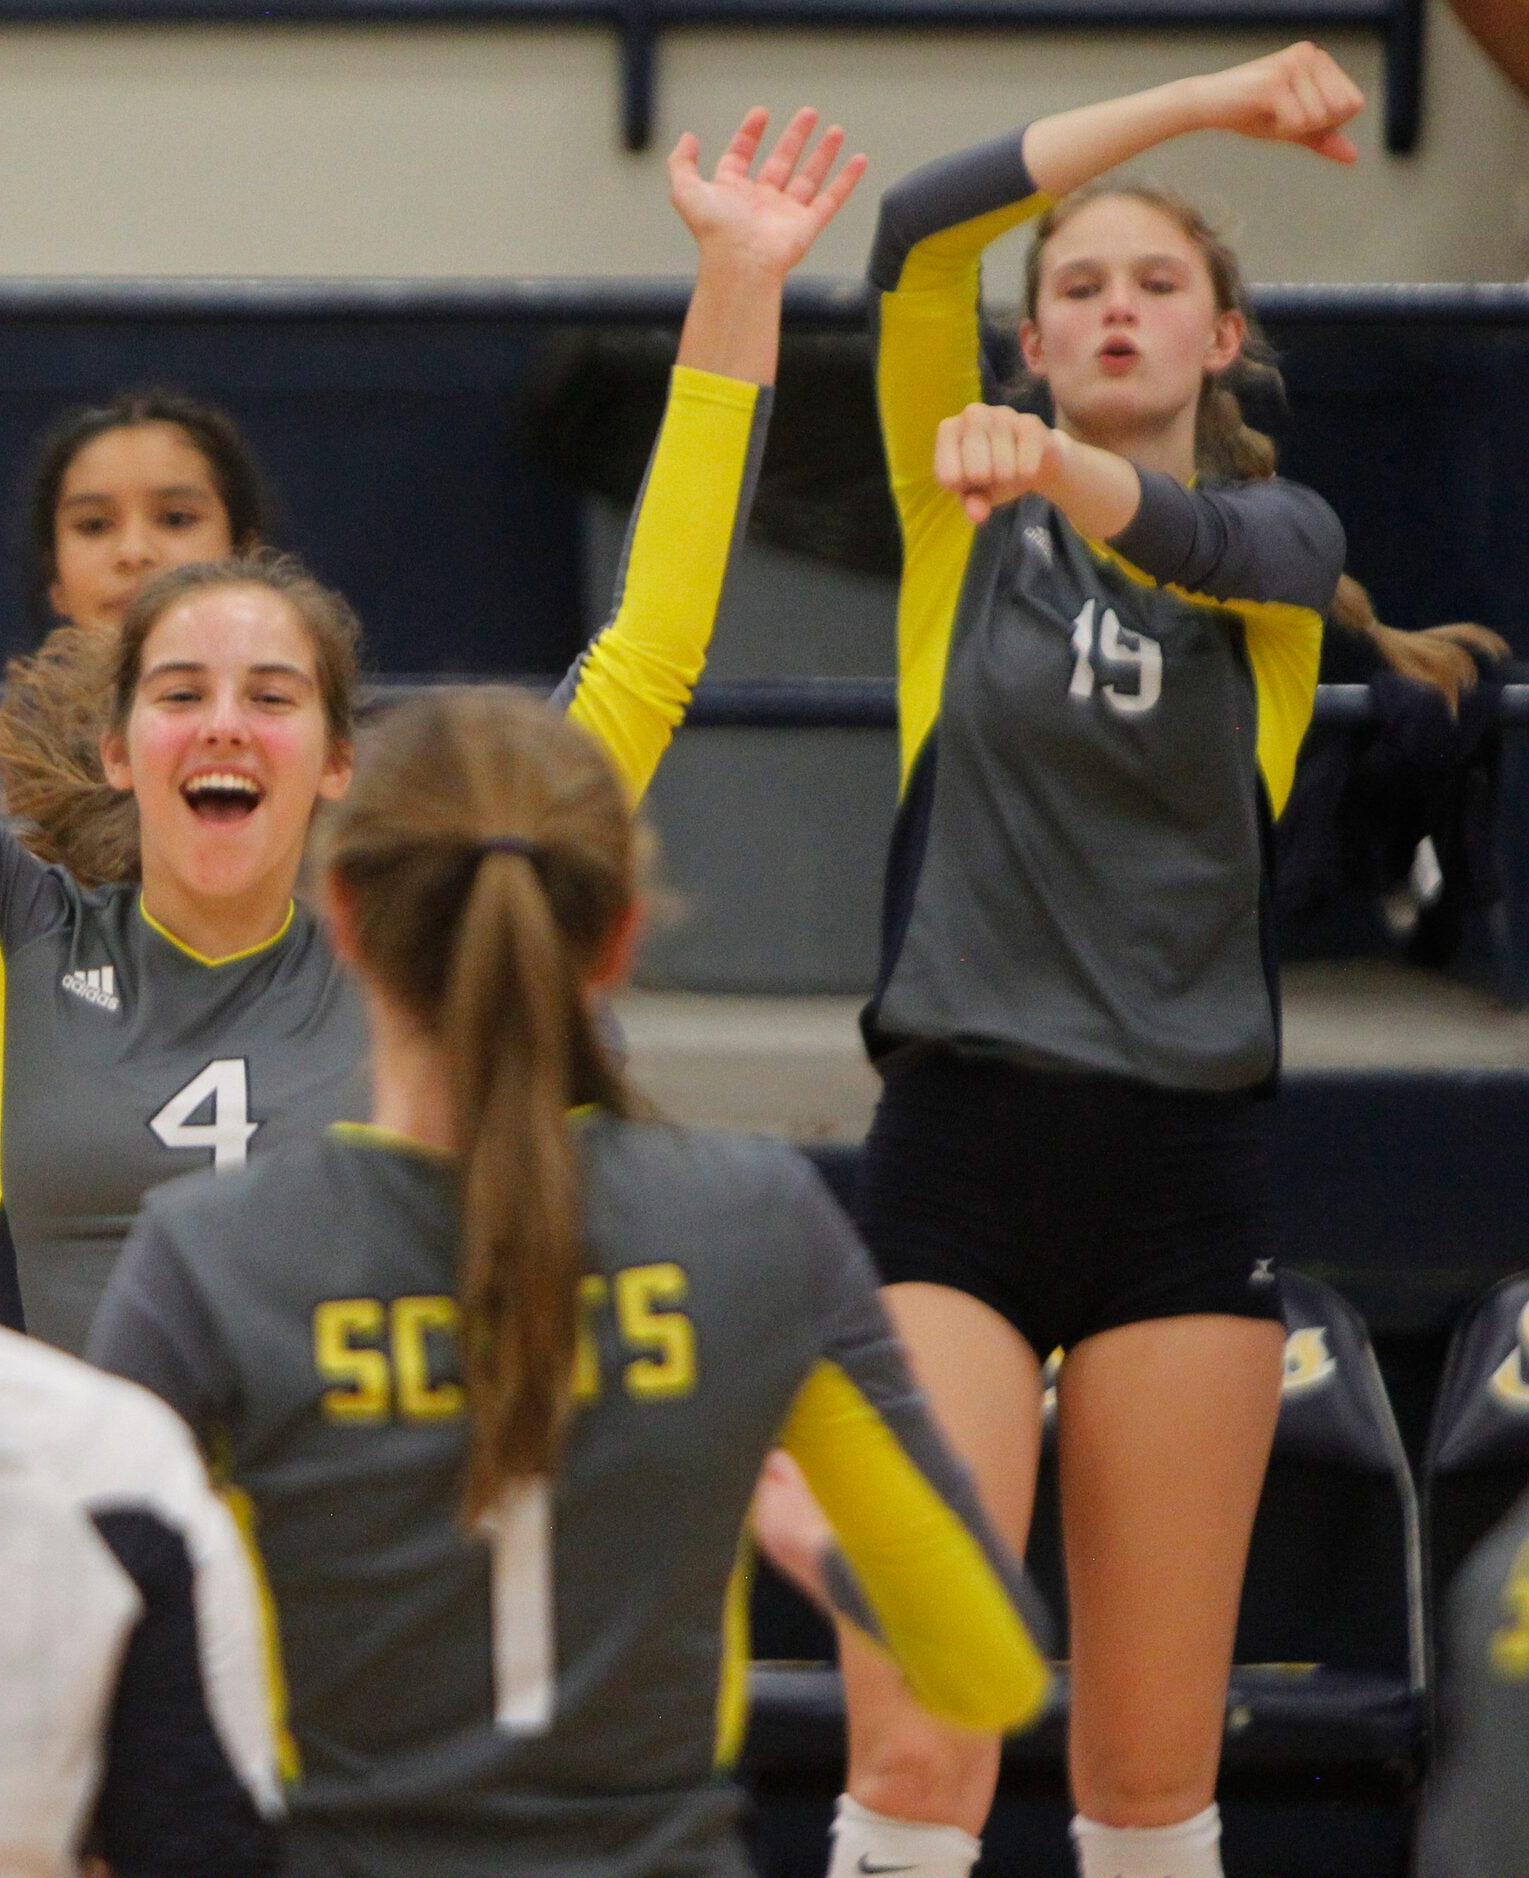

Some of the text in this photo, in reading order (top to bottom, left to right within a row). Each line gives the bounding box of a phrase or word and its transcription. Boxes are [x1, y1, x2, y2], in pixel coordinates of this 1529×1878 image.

[1069, 598, 1163, 714] 19
[62, 973, 120, 1011] adidas
[149, 1057, 261, 1170] 4
[475, 1476, 556, 1732] 1
